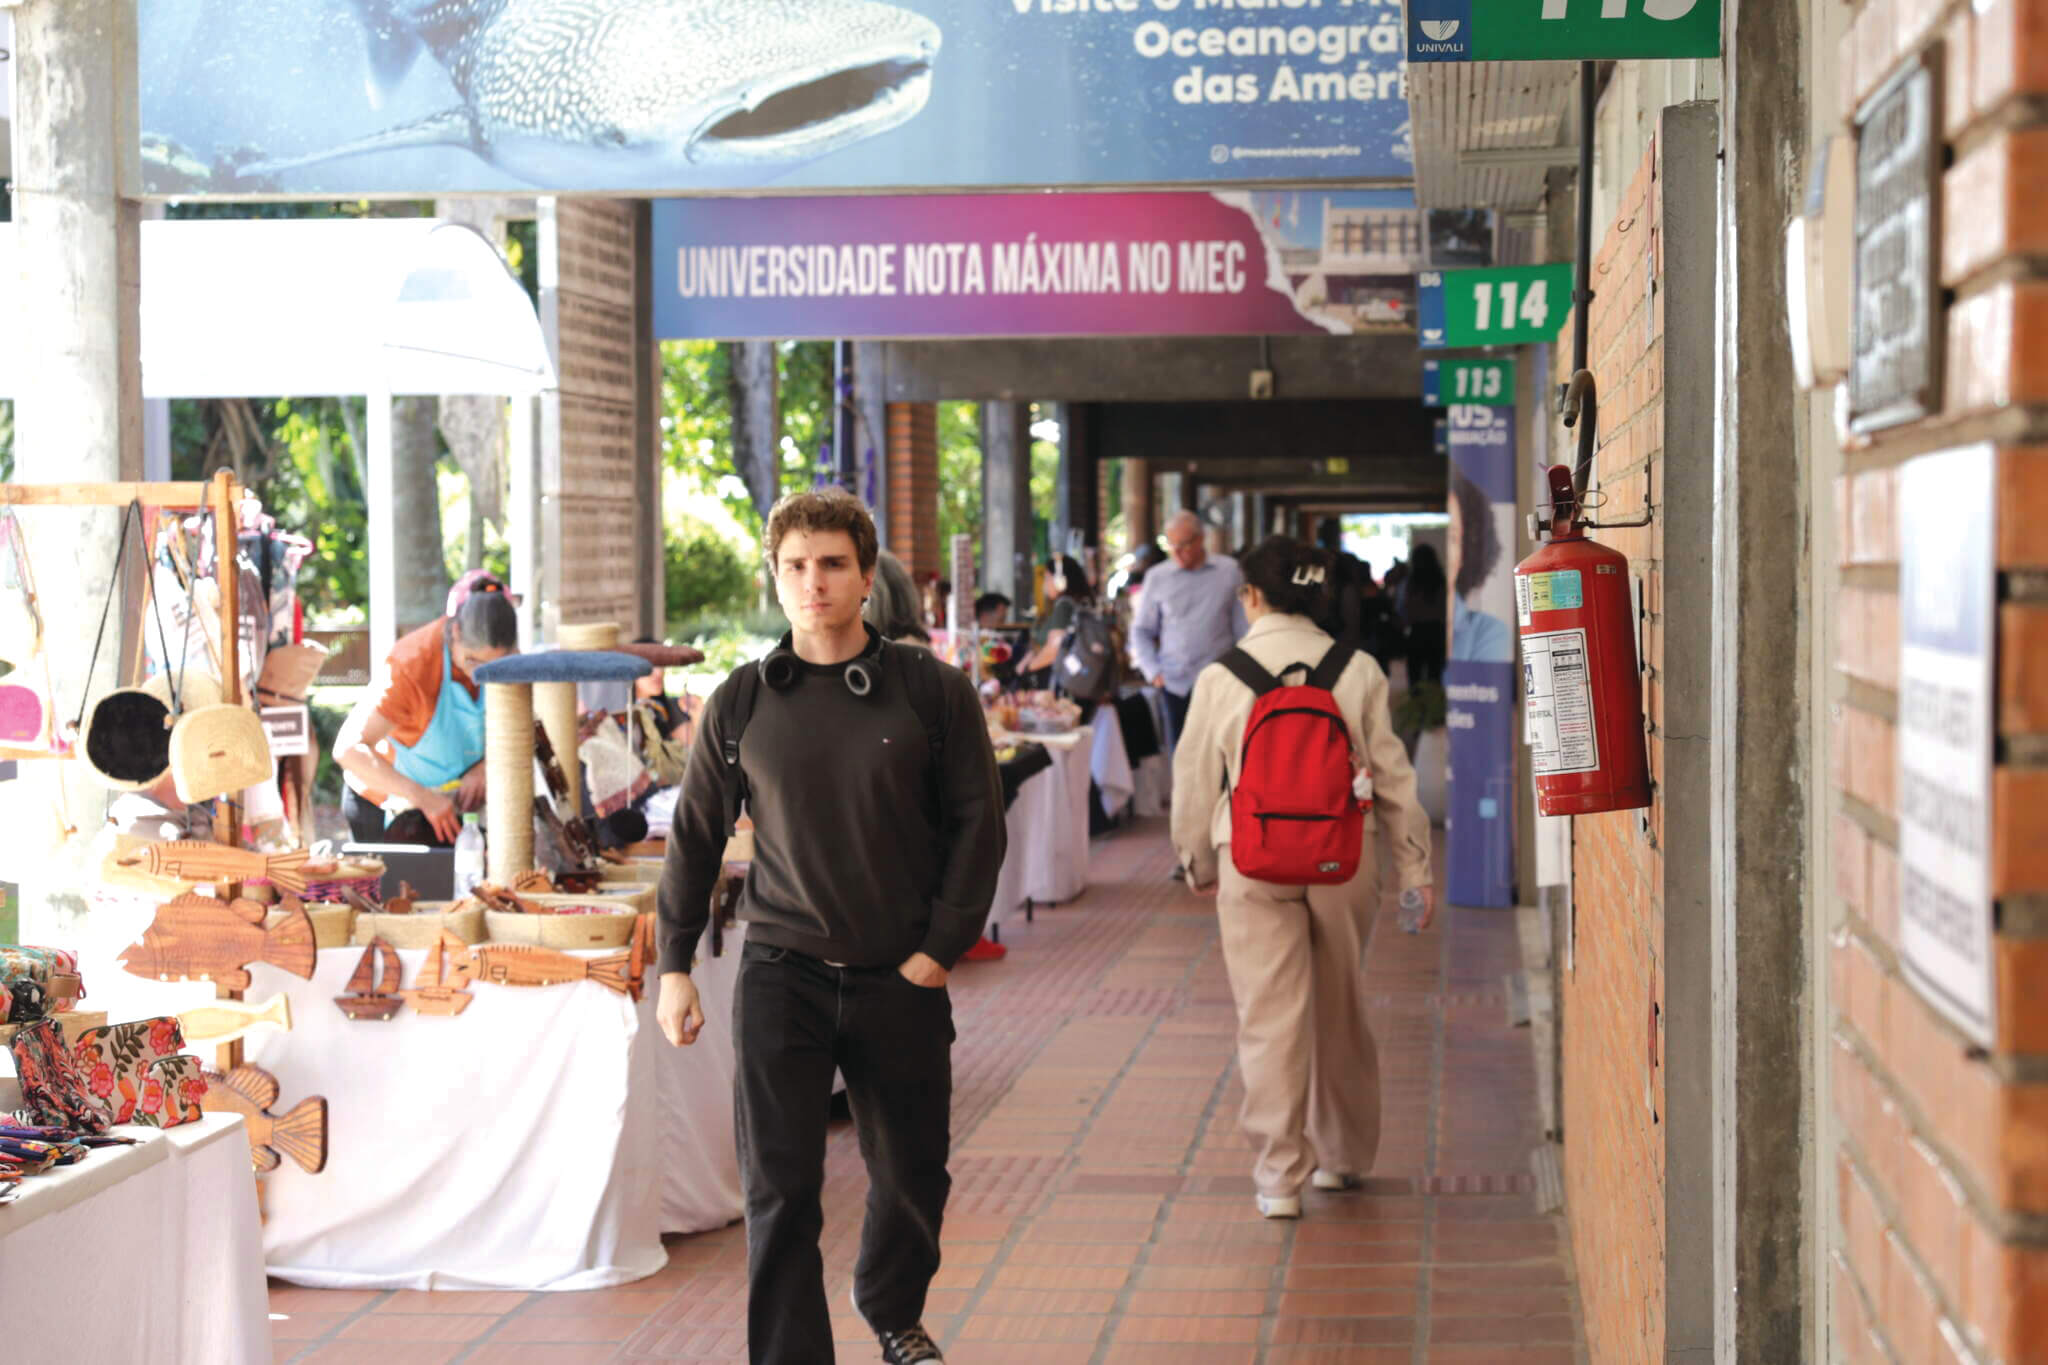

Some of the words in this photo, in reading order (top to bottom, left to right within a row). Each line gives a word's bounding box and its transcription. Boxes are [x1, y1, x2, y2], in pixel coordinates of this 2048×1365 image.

[1134, 13, 1398, 62] Oceanográ
[1416, 43, 1464, 53] UNIVALI
[1172, 66, 1258, 103] das
[678, 244, 896, 298] UNIVERSIDADE
[903, 242, 985, 296] NOTA
[992, 233, 1121, 295] MÁXIMA
[1128, 241, 1171, 294] NO
[1178, 241, 1246, 294] MEC
[1474, 281, 1548, 330] 114
[1455, 367, 1502, 398] 113
